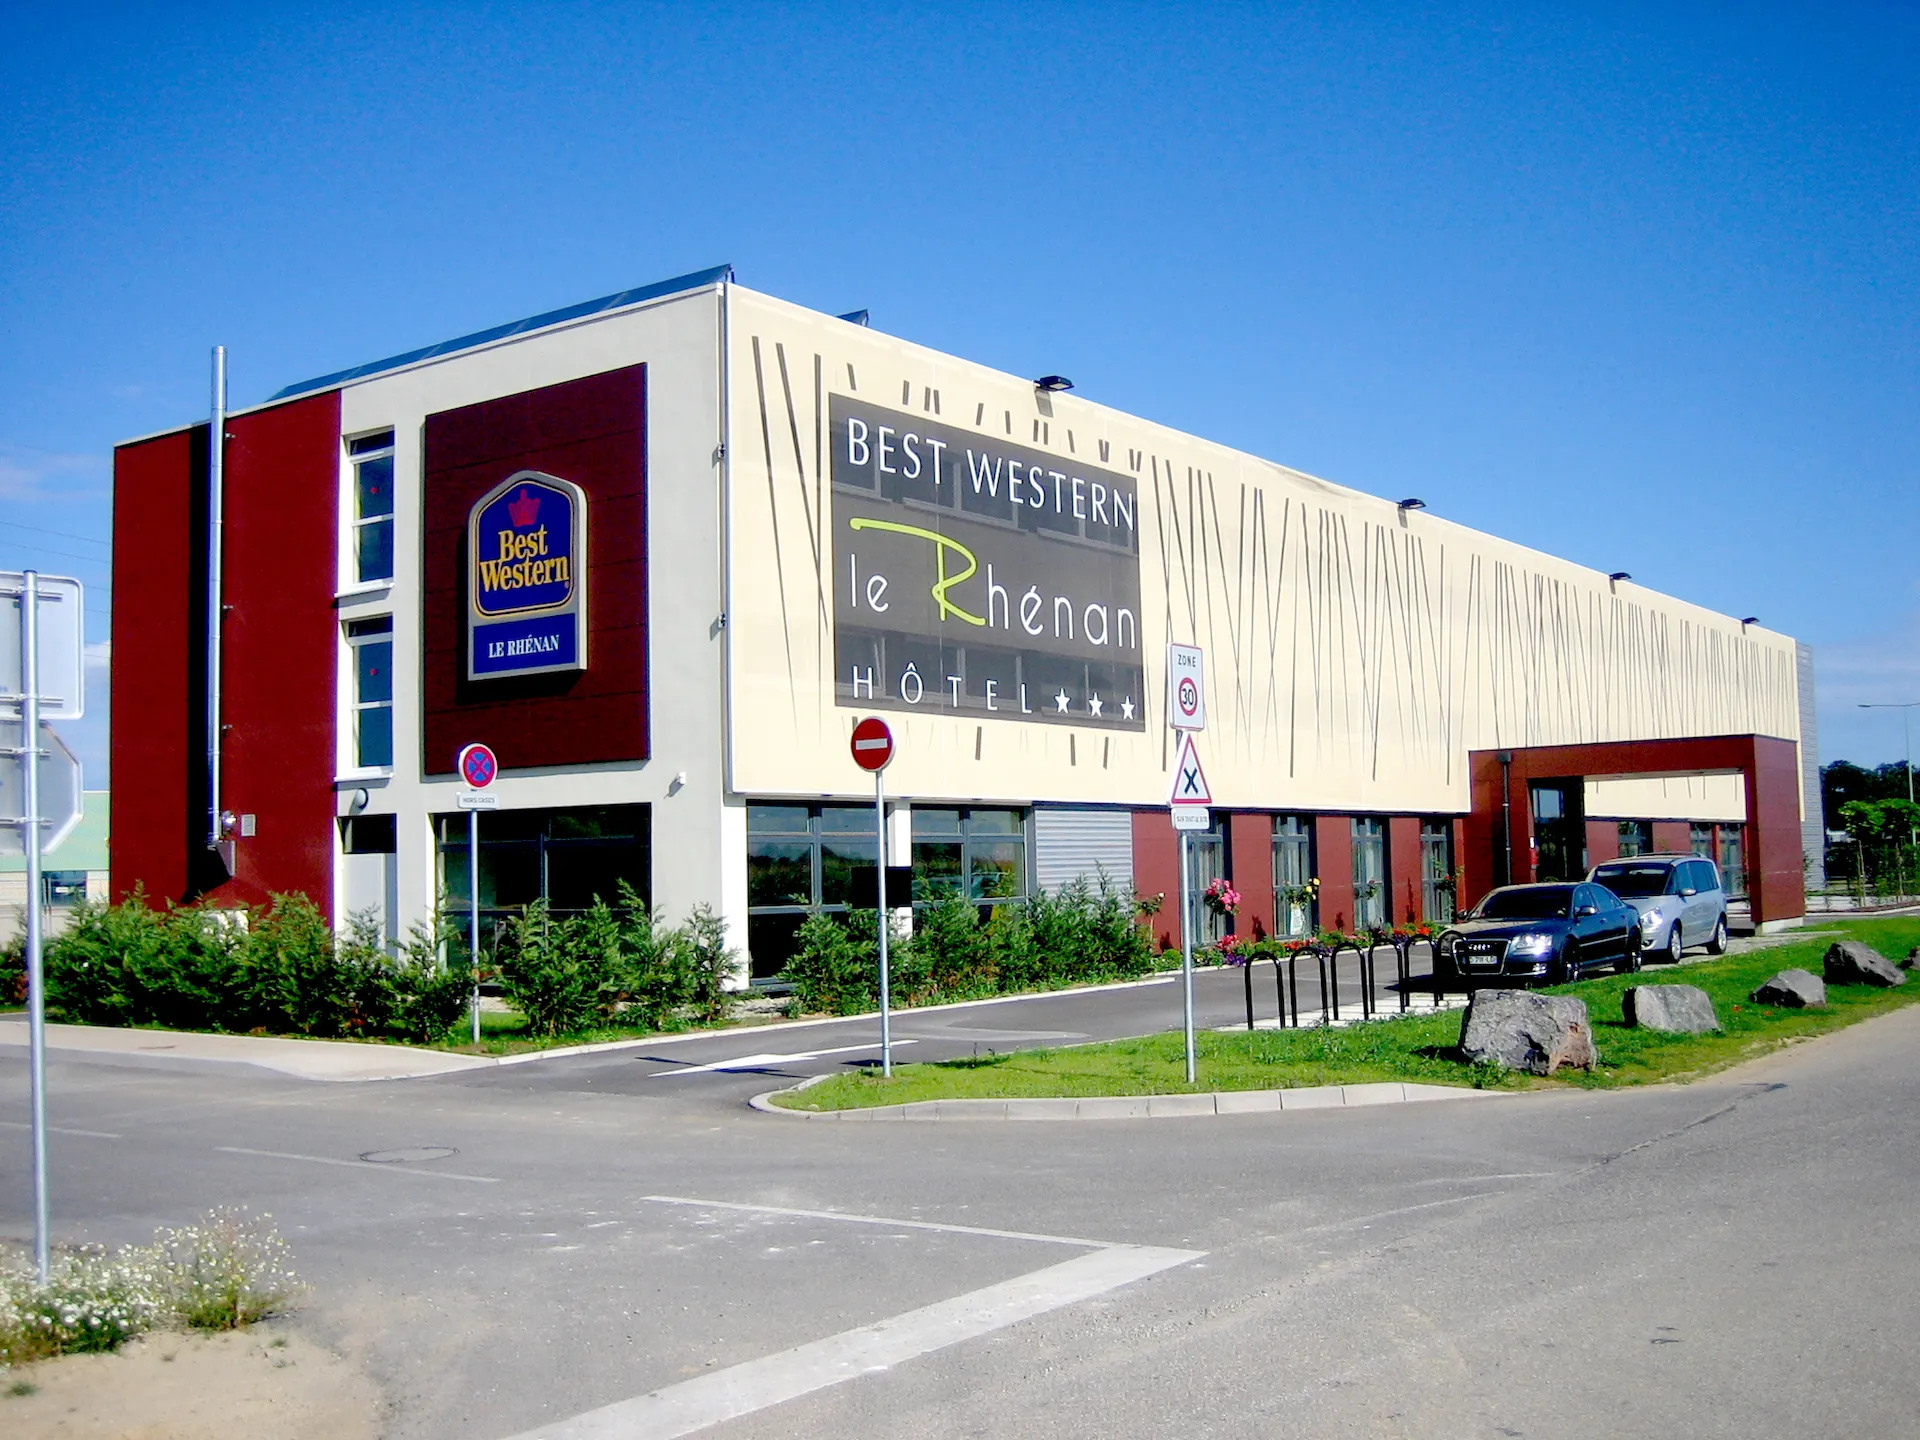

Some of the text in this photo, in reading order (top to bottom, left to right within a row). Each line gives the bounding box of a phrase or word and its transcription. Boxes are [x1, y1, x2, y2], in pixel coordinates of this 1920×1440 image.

[848, 417, 1135, 531] BEST WESTERN
[498, 524, 549, 563] Best
[479, 552, 570, 592] Western
[849, 517, 1136, 650] le Rhénan
[488, 634, 559, 659] LE RHÉNAN
[1178, 654, 1196, 667] ZONE
[1182, 689, 1195, 705] 30
